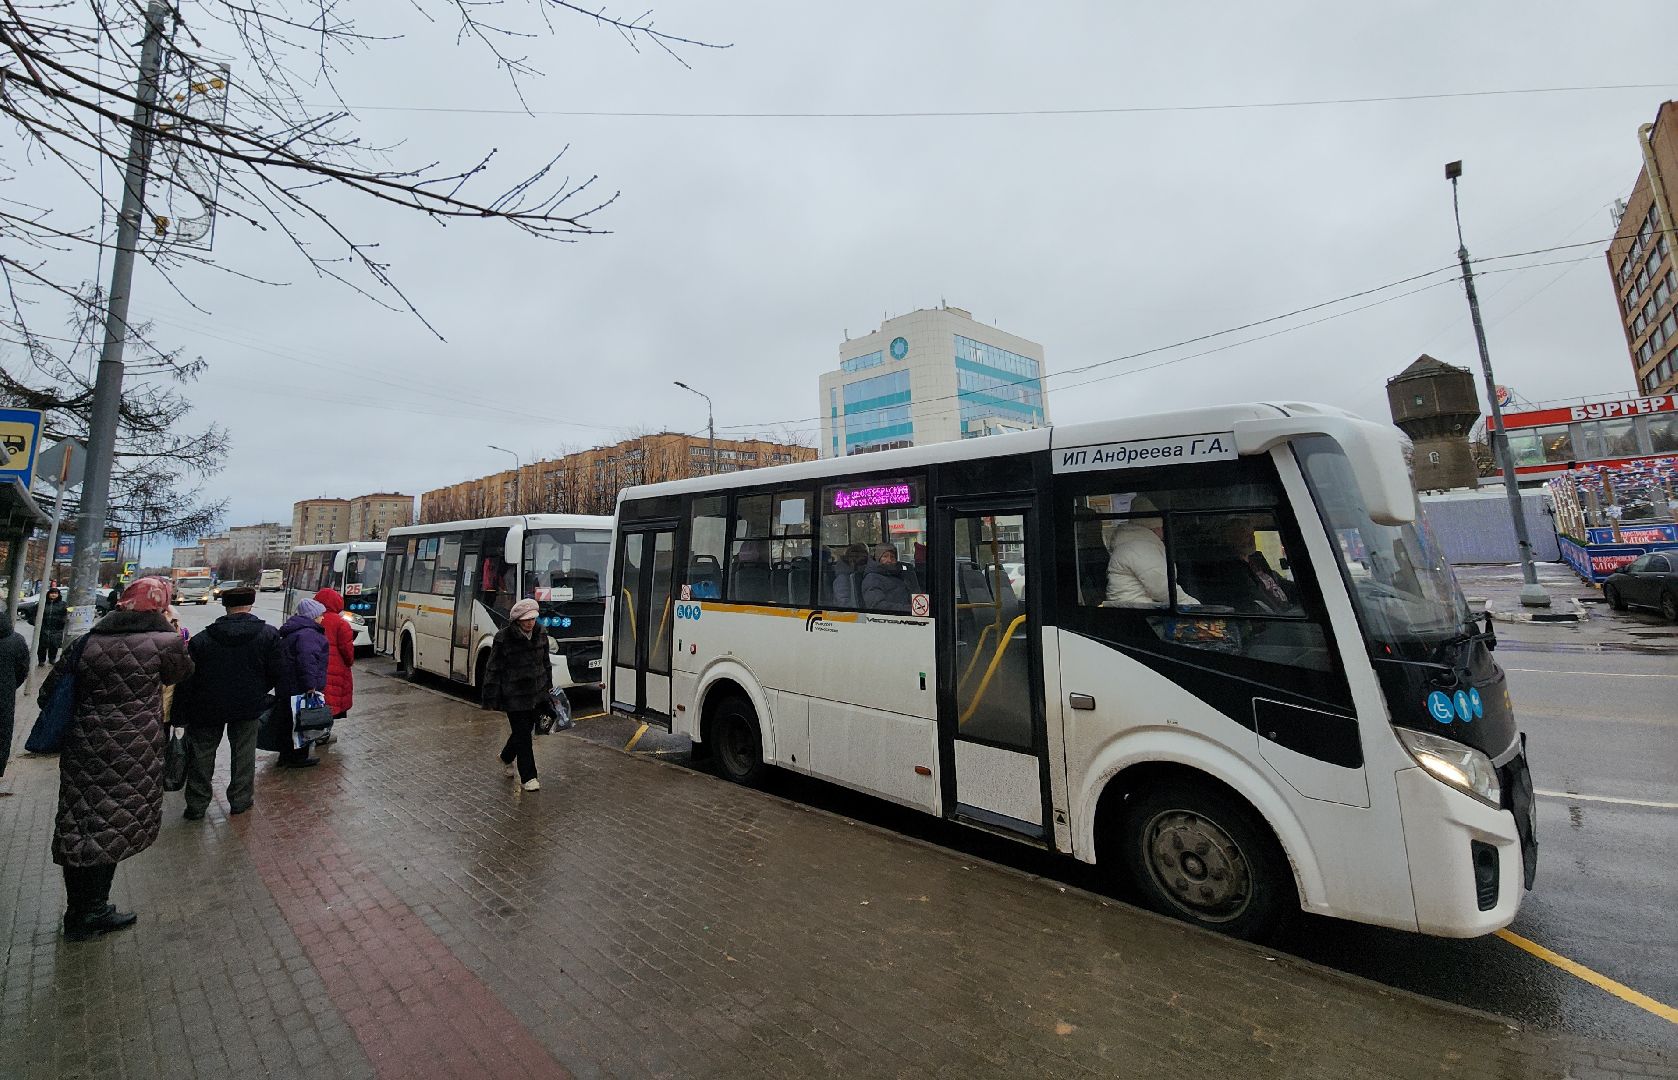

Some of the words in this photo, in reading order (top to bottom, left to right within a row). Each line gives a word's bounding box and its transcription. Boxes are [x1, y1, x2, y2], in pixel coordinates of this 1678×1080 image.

[1570, 397, 1666, 421] БУРГЕР
[1062, 450, 1087, 466] ИП
[1091, 445, 1183, 464] Андреева
[1190, 438, 1229, 456] Г.А.
[346, 584, 361, 595] 25
[538, 588, 550, 601] 7
